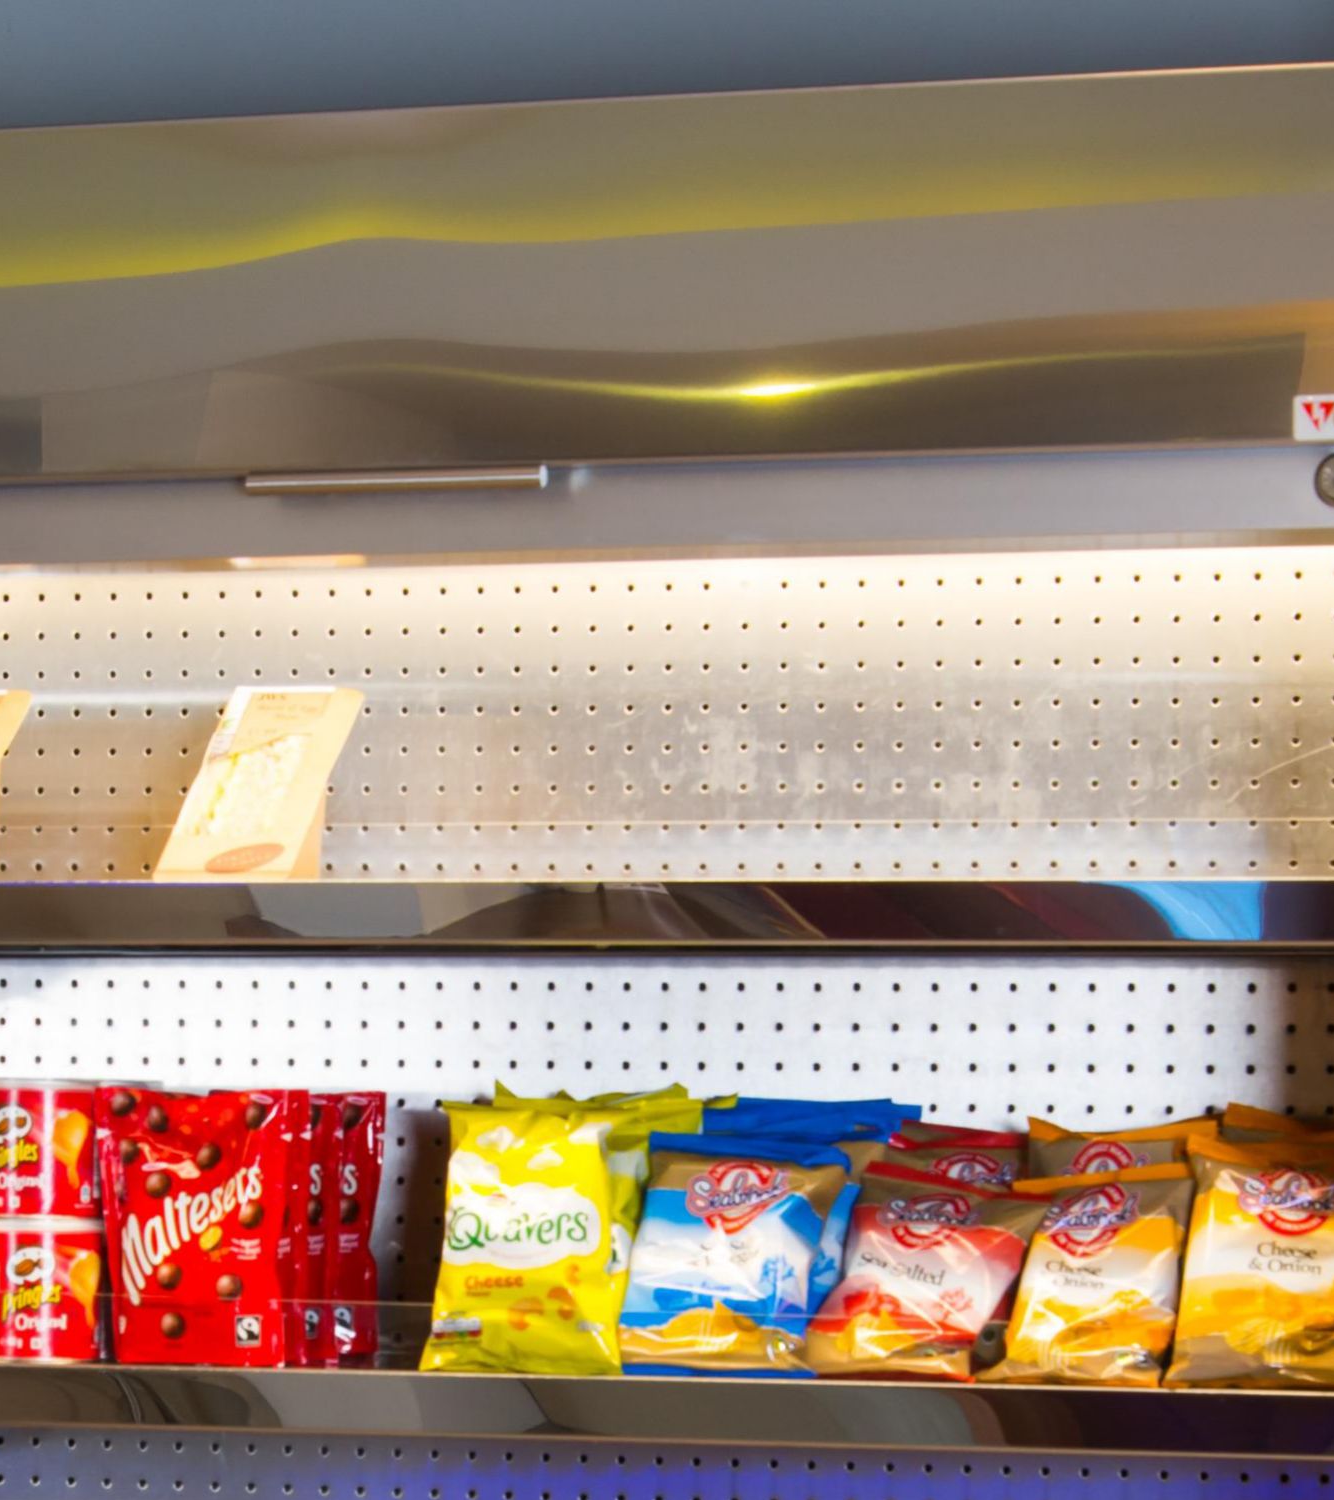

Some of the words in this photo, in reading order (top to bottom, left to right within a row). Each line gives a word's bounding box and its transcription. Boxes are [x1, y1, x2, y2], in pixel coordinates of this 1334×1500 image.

[121, 1165, 263, 1306] Maltesers
[1257, 1241, 1318, 1260] Cheese
[1267, 1257, 1322, 1276] Onion
